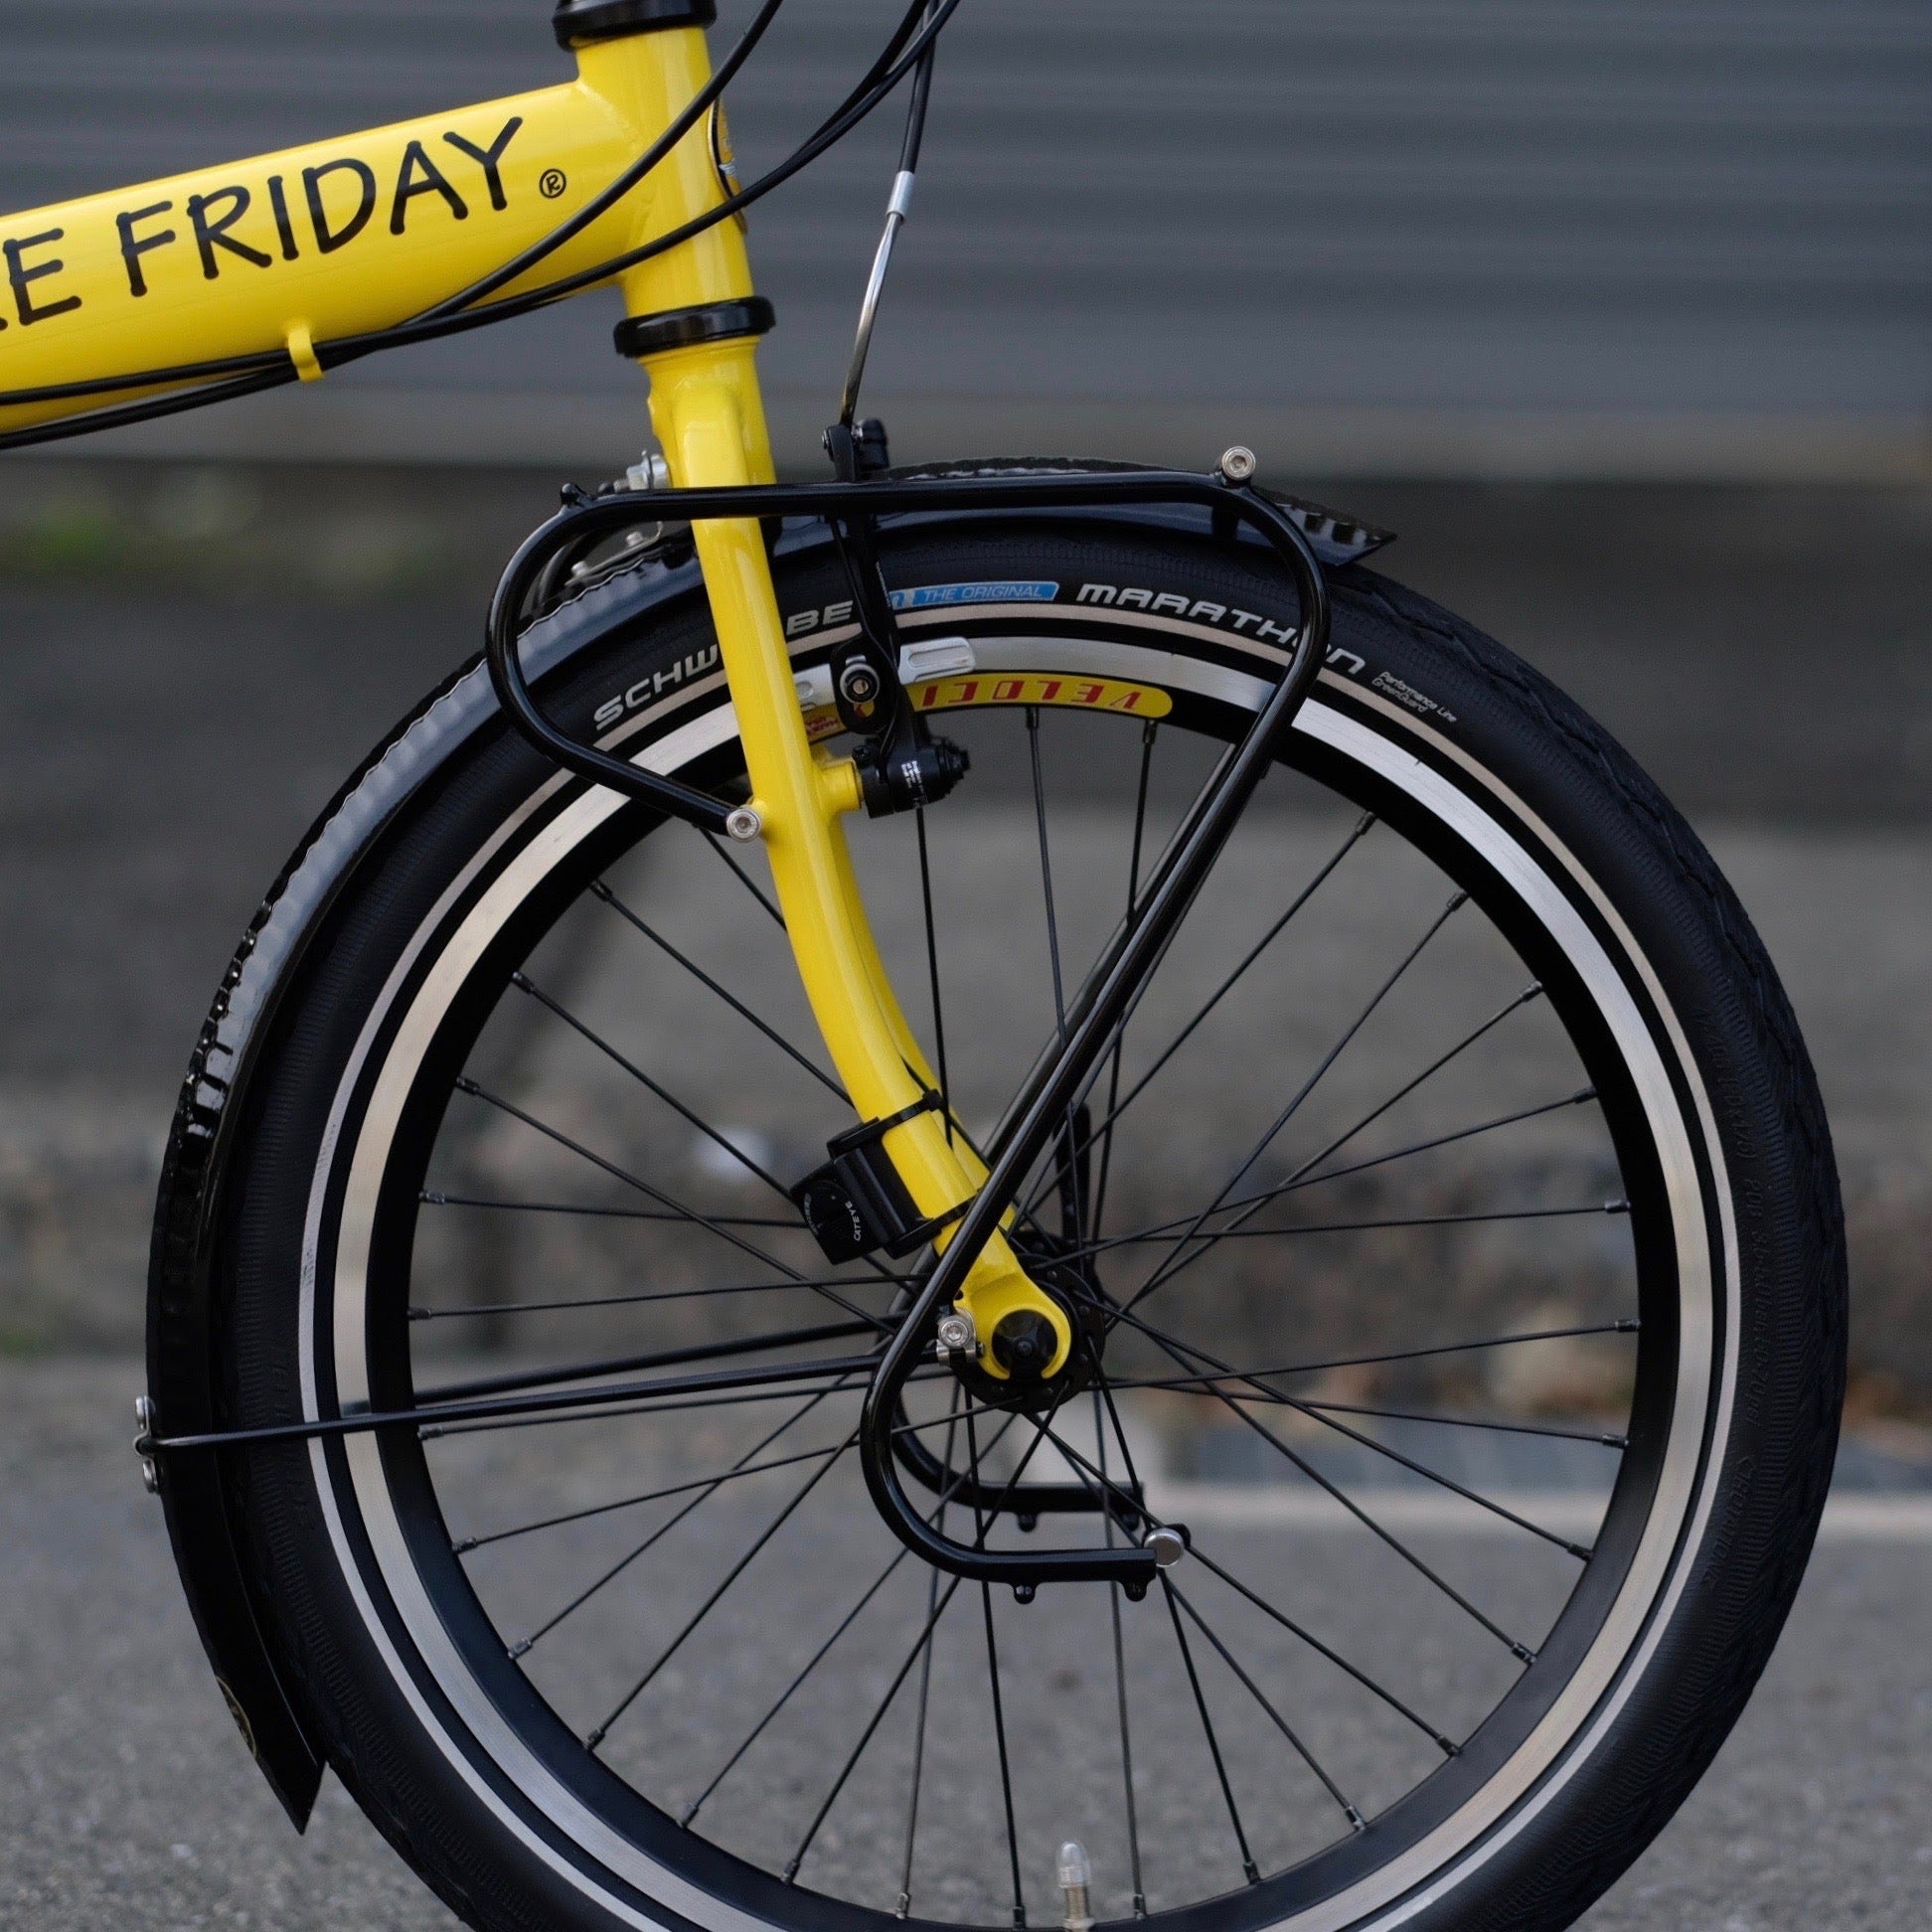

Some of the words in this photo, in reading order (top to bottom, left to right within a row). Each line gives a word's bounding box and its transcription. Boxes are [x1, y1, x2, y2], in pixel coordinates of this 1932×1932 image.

[0, 227, 82, 331] E
[115, 116, 524, 297] FRIDAY
[923, 586, 956, 603] THE
[962, 585, 1042, 602] ORIGINAL
[593, 600, 854, 730] SCHWBE
[1076, 583, 1367, 675] MARATHN
[920, 680, 1143, 710] VELOCI
[1371, 677, 1429, 714] GreenGuard
[1378, 671, 1438, 710] Performance
[1437, 707, 1458, 723] Line
[844, 1200, 863, 1242] CATEYE
